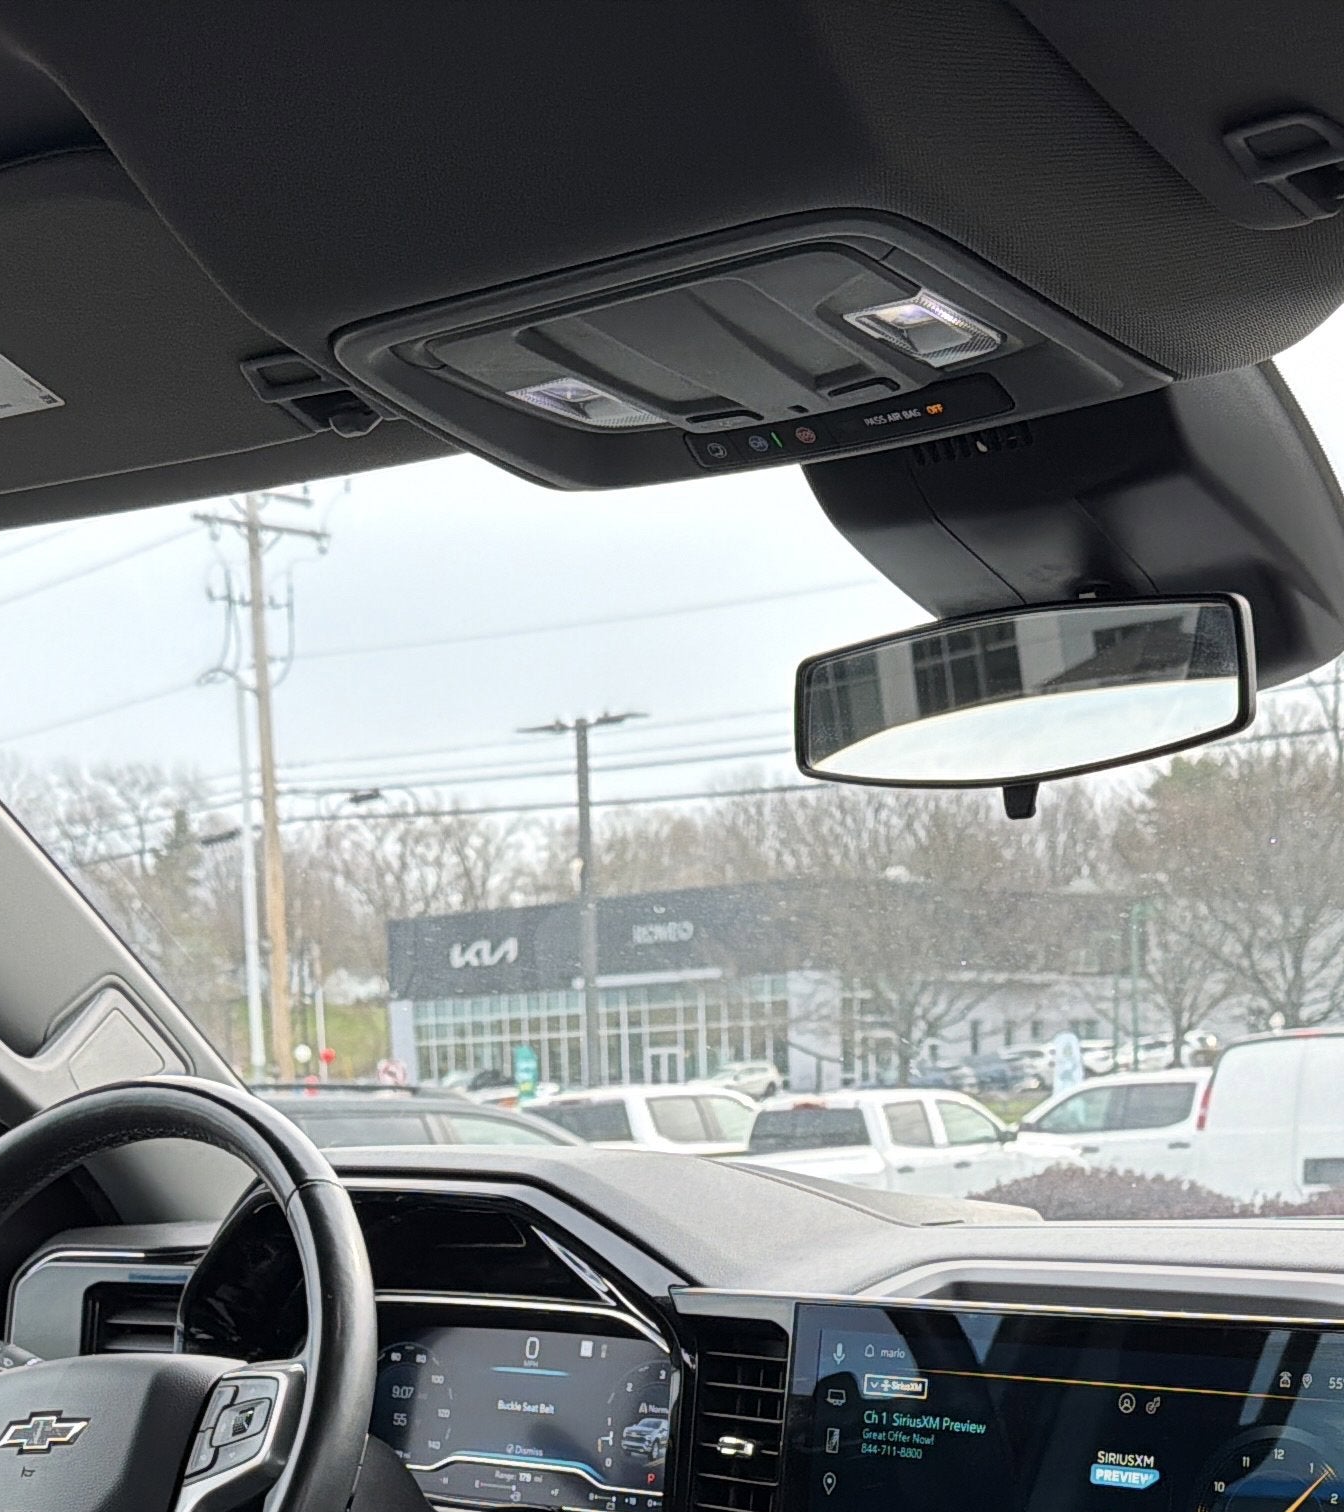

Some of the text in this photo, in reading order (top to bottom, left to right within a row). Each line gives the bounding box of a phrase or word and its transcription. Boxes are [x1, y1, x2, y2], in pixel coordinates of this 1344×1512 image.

[864, 403, 944, 427] PASS AIR BAG OFF
[525, 1337, 540, 1359] 0
[431, 1374, 445, 1385] 100
[891, 1381, 923, 1393] SiriusXM
[497, 1400, 555, 1415] Buckle Seat Belt
[863, 1410, 986, 1434] Ch 1 SiriusXM Preview
[862, 1428, 935, 1446] Great Offer Now!
[515, 1445, 544, 1458] Dismiss
[861, 1443, 923, 1460] 844-711-8800
[1097, 1450, 1154, 1467] SIRIUSXM
[1273, 1448, 1285, 1460] 12
[1242, 1456, 1250, 1468] 11
[647, 1473, 656, 1483] P
[1095, 1468, 1153, 1484] PREVIEW
[1214, 1480, 1225, 1493] 10
[1330, 1493, 1338, 1504] 2
